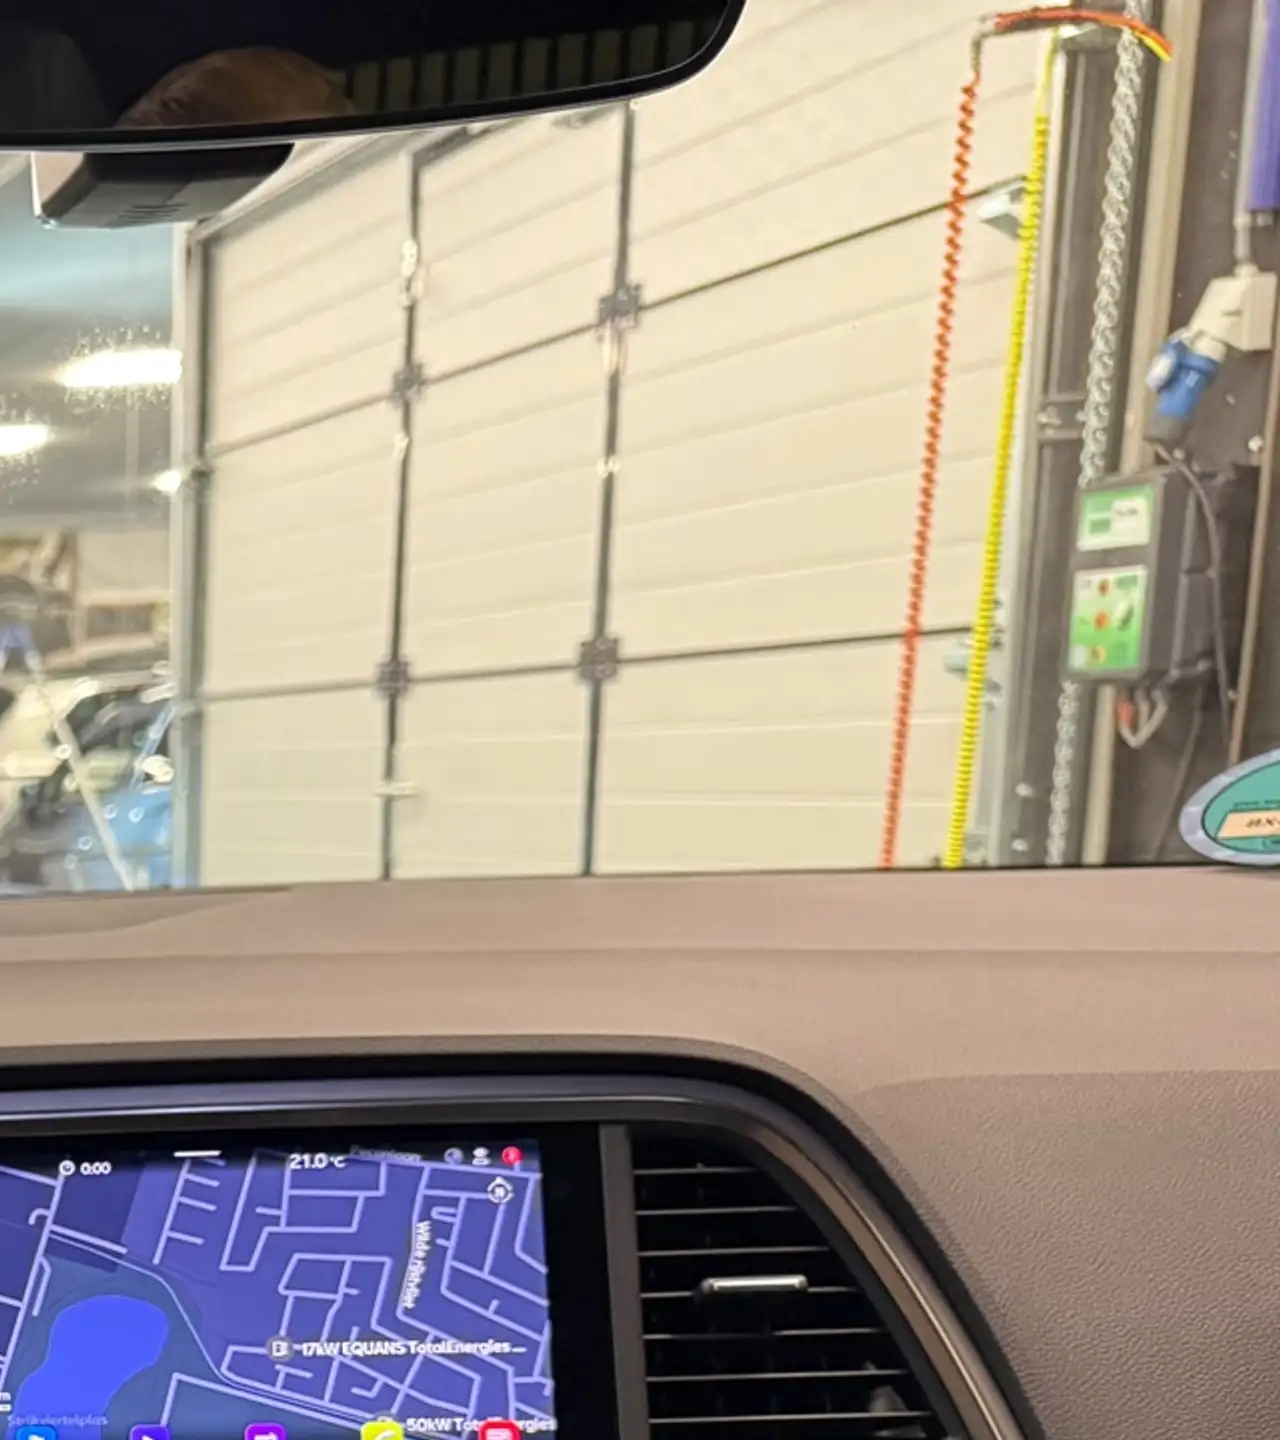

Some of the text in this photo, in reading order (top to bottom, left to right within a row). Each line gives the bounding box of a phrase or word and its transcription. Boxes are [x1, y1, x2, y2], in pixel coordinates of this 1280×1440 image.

[79, 1161, 113, 1176] 0:00
[290, 1152, 329, 1169] 21.0
[342, 1340, 407, 1357] EQUANS
[406, 1416, 452, 1432] 50kW
